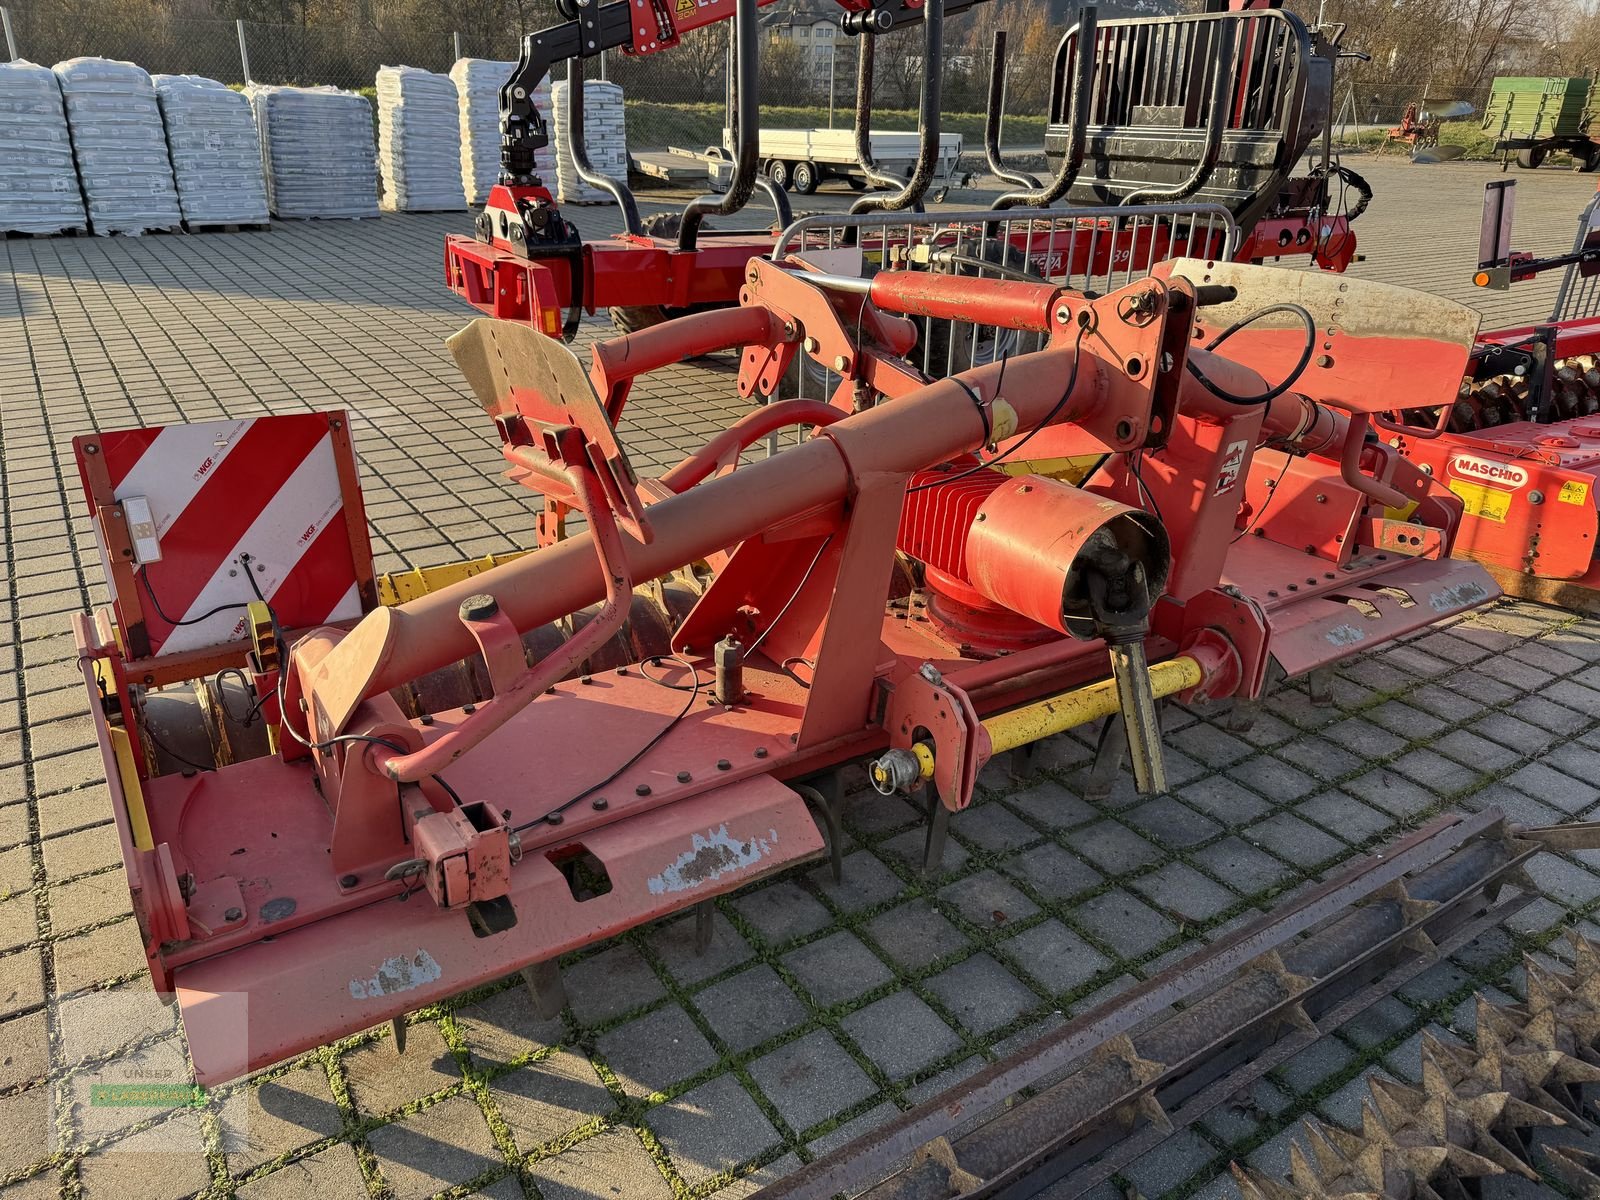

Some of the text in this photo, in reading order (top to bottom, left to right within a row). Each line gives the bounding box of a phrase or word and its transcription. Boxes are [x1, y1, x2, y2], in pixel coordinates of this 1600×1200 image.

[197, 456, 213, 475] WGF
[1458, 459, 1523, 482] MASCHIO
[301, 523, 316, 541] WGF
